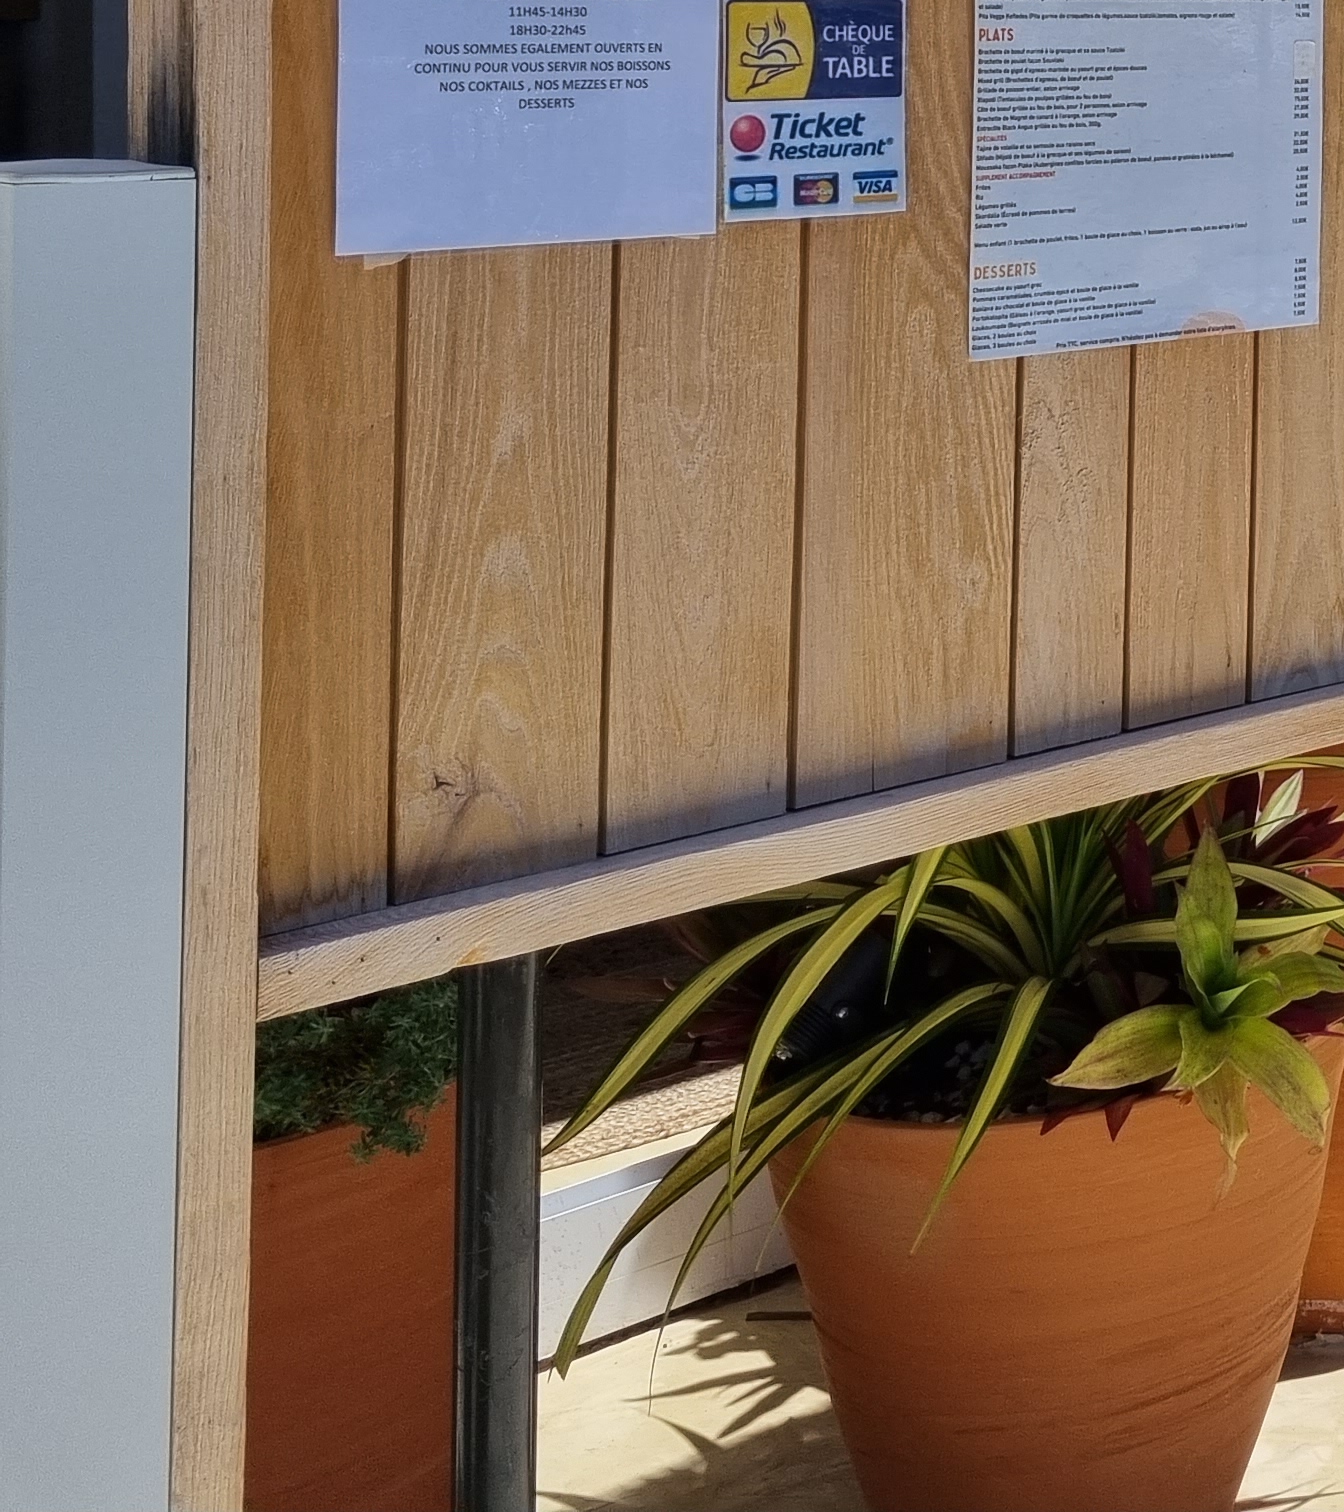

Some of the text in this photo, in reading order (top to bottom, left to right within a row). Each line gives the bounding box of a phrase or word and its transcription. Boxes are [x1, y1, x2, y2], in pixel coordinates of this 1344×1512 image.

[508, 6, 587, 17] 11H45-14H30
[509, 24, 586, 35] 18H30-22h45
[822, 21, 895, 44] CHÈQUE
[979, 27, 1014, 42] PLATS
[424, 42, 662, 55] NOUS SOMMES EGALEMENT OUVERTS EN
[852, 45, 866, 55] DE
[413, 60, 671, 74] CONTINU POUR VOUS SERVIR NOS BOISSONS
[823, 56, 895, 78] TABLE
[439, 80, 465, 92] NOS
[534, 79, 559, 90] NOS
[561, 78, 607, 90] MEZZES
[608, 78, 623, 89] ET
[625, 78, 648, 88] NOS
[518, 97, 574, 109] DESSERTS
[770, 111, 866, 140] Ticket
[857, 180, 893, 194] VISA
[973, 261, 1037, 281] DESSERTS
